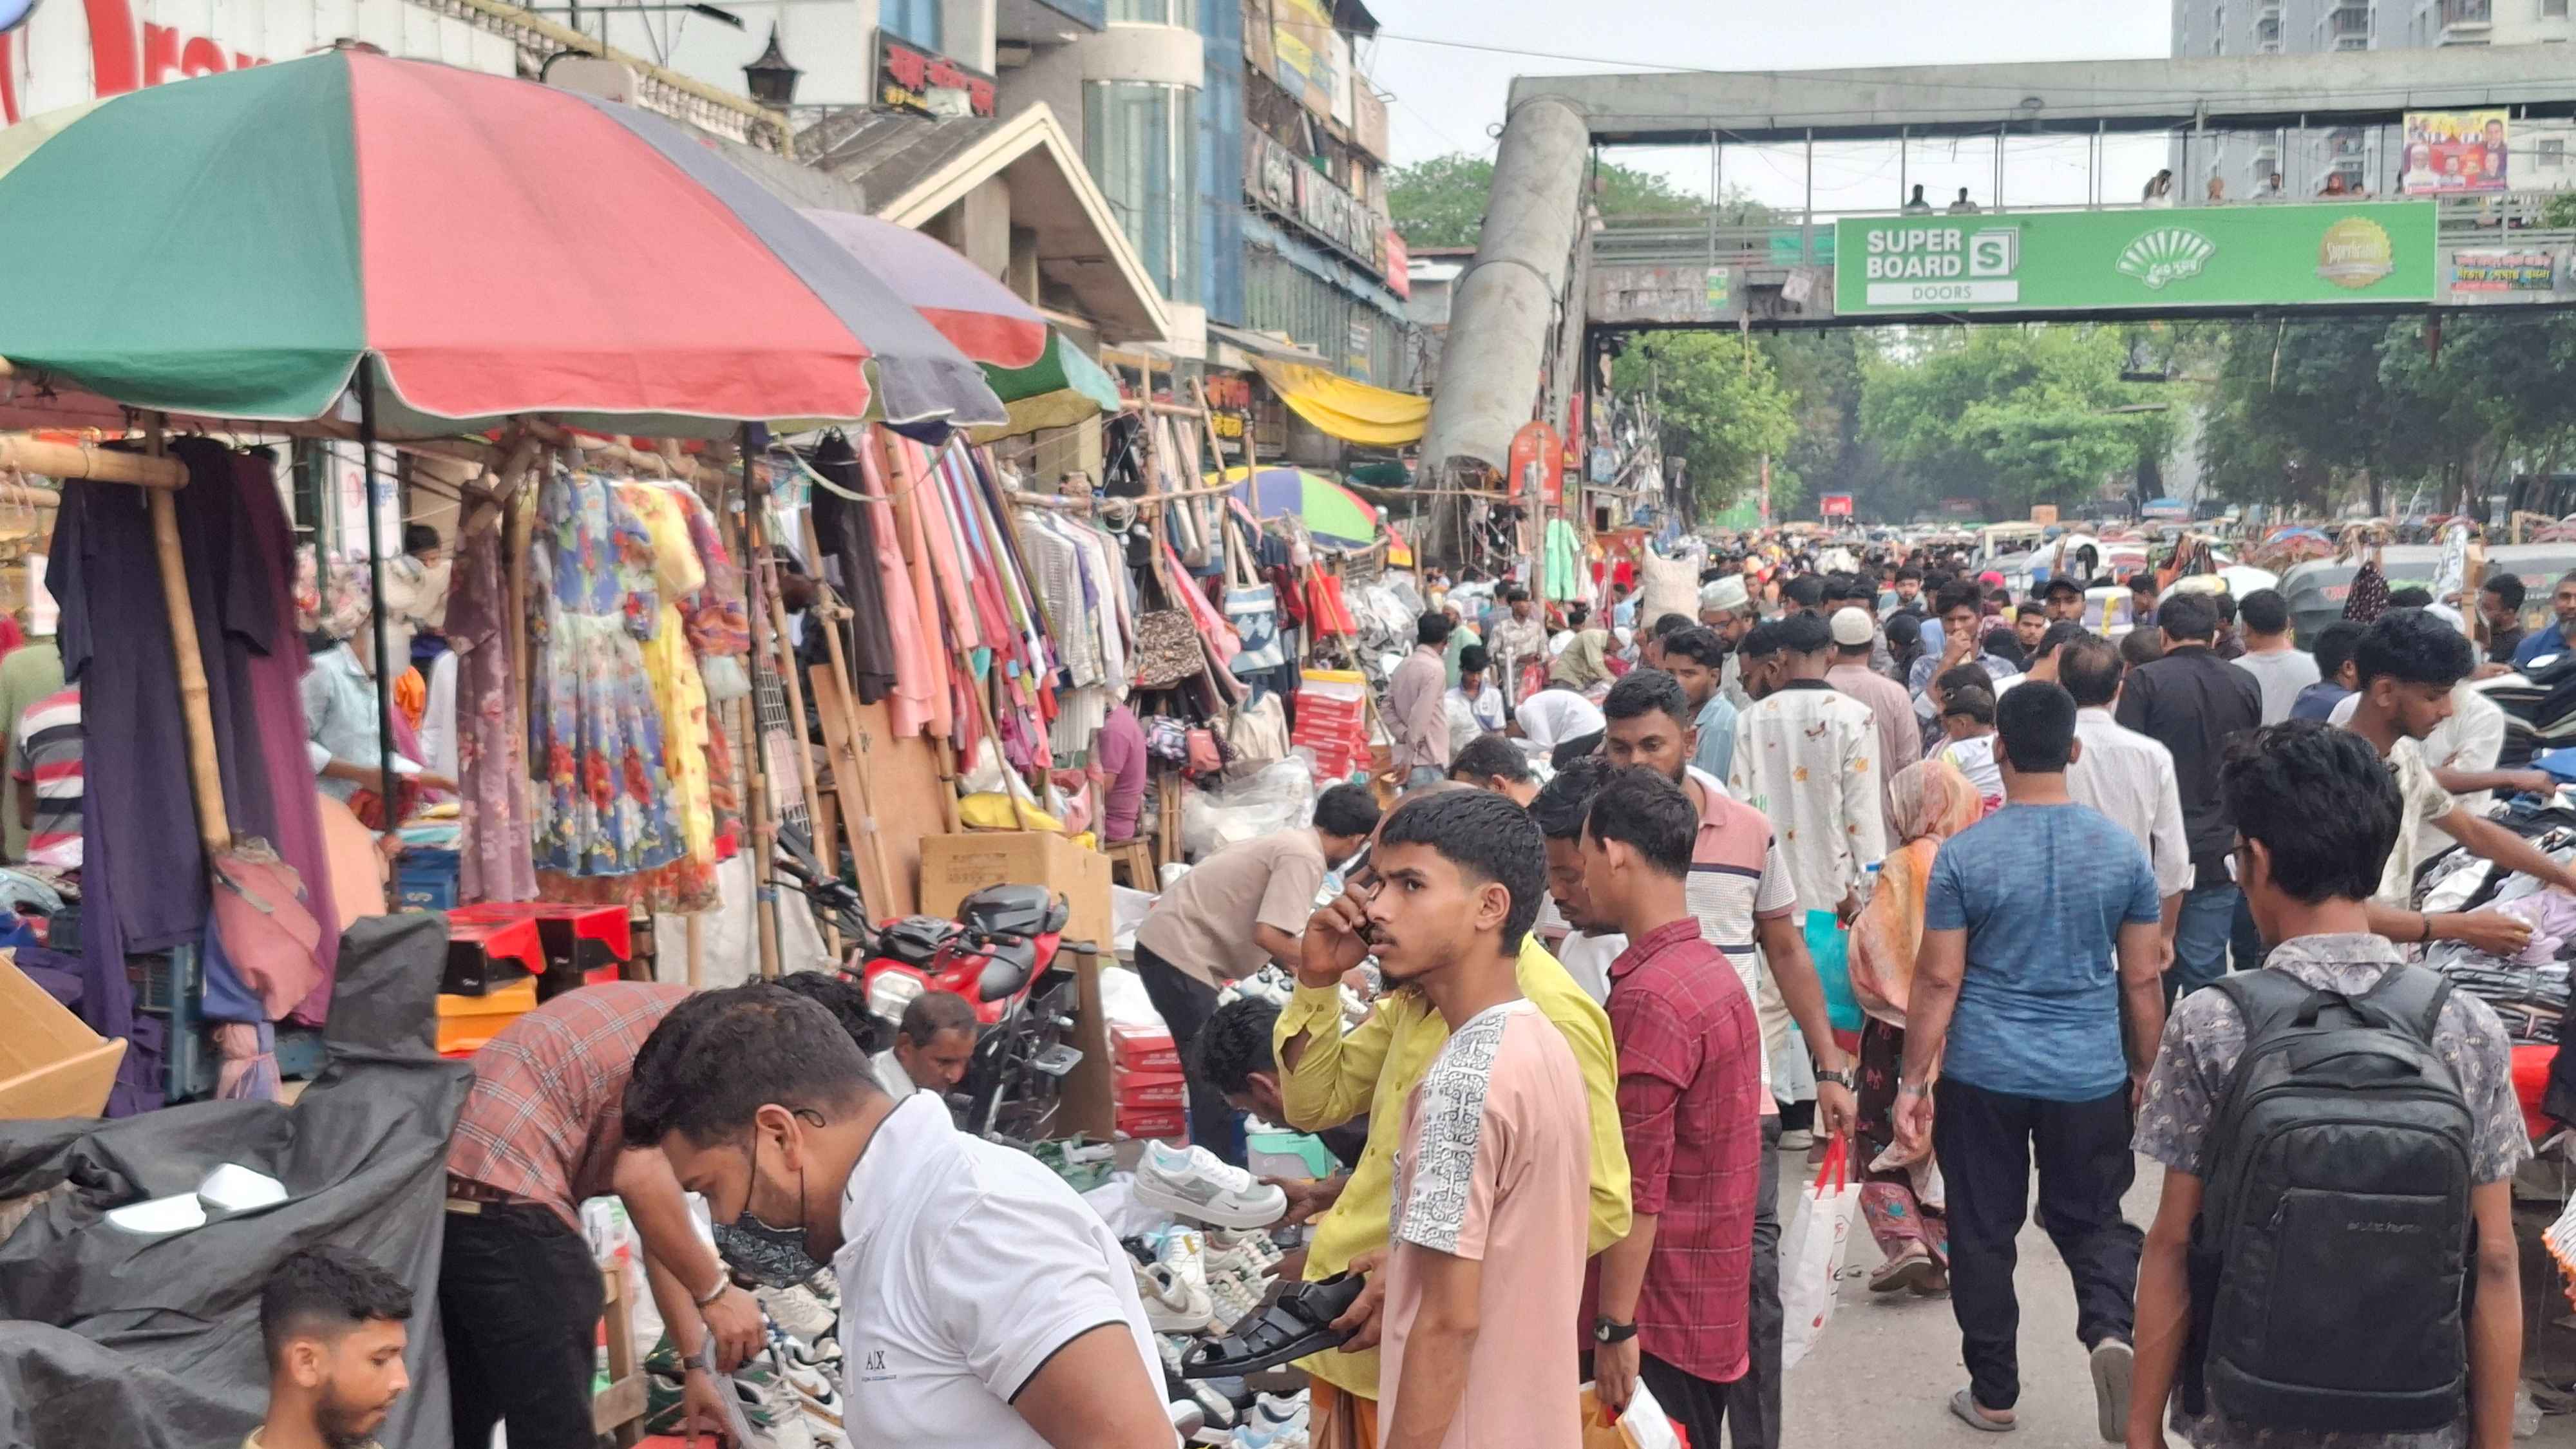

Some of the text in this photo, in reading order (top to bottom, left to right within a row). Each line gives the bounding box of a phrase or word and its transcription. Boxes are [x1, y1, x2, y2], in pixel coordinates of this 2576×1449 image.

[1866, 228, 1962, 253] SUPER
[1866, 242, 2003, 279] BOARD S
[1911, 285, 1973, 300] DOORS
